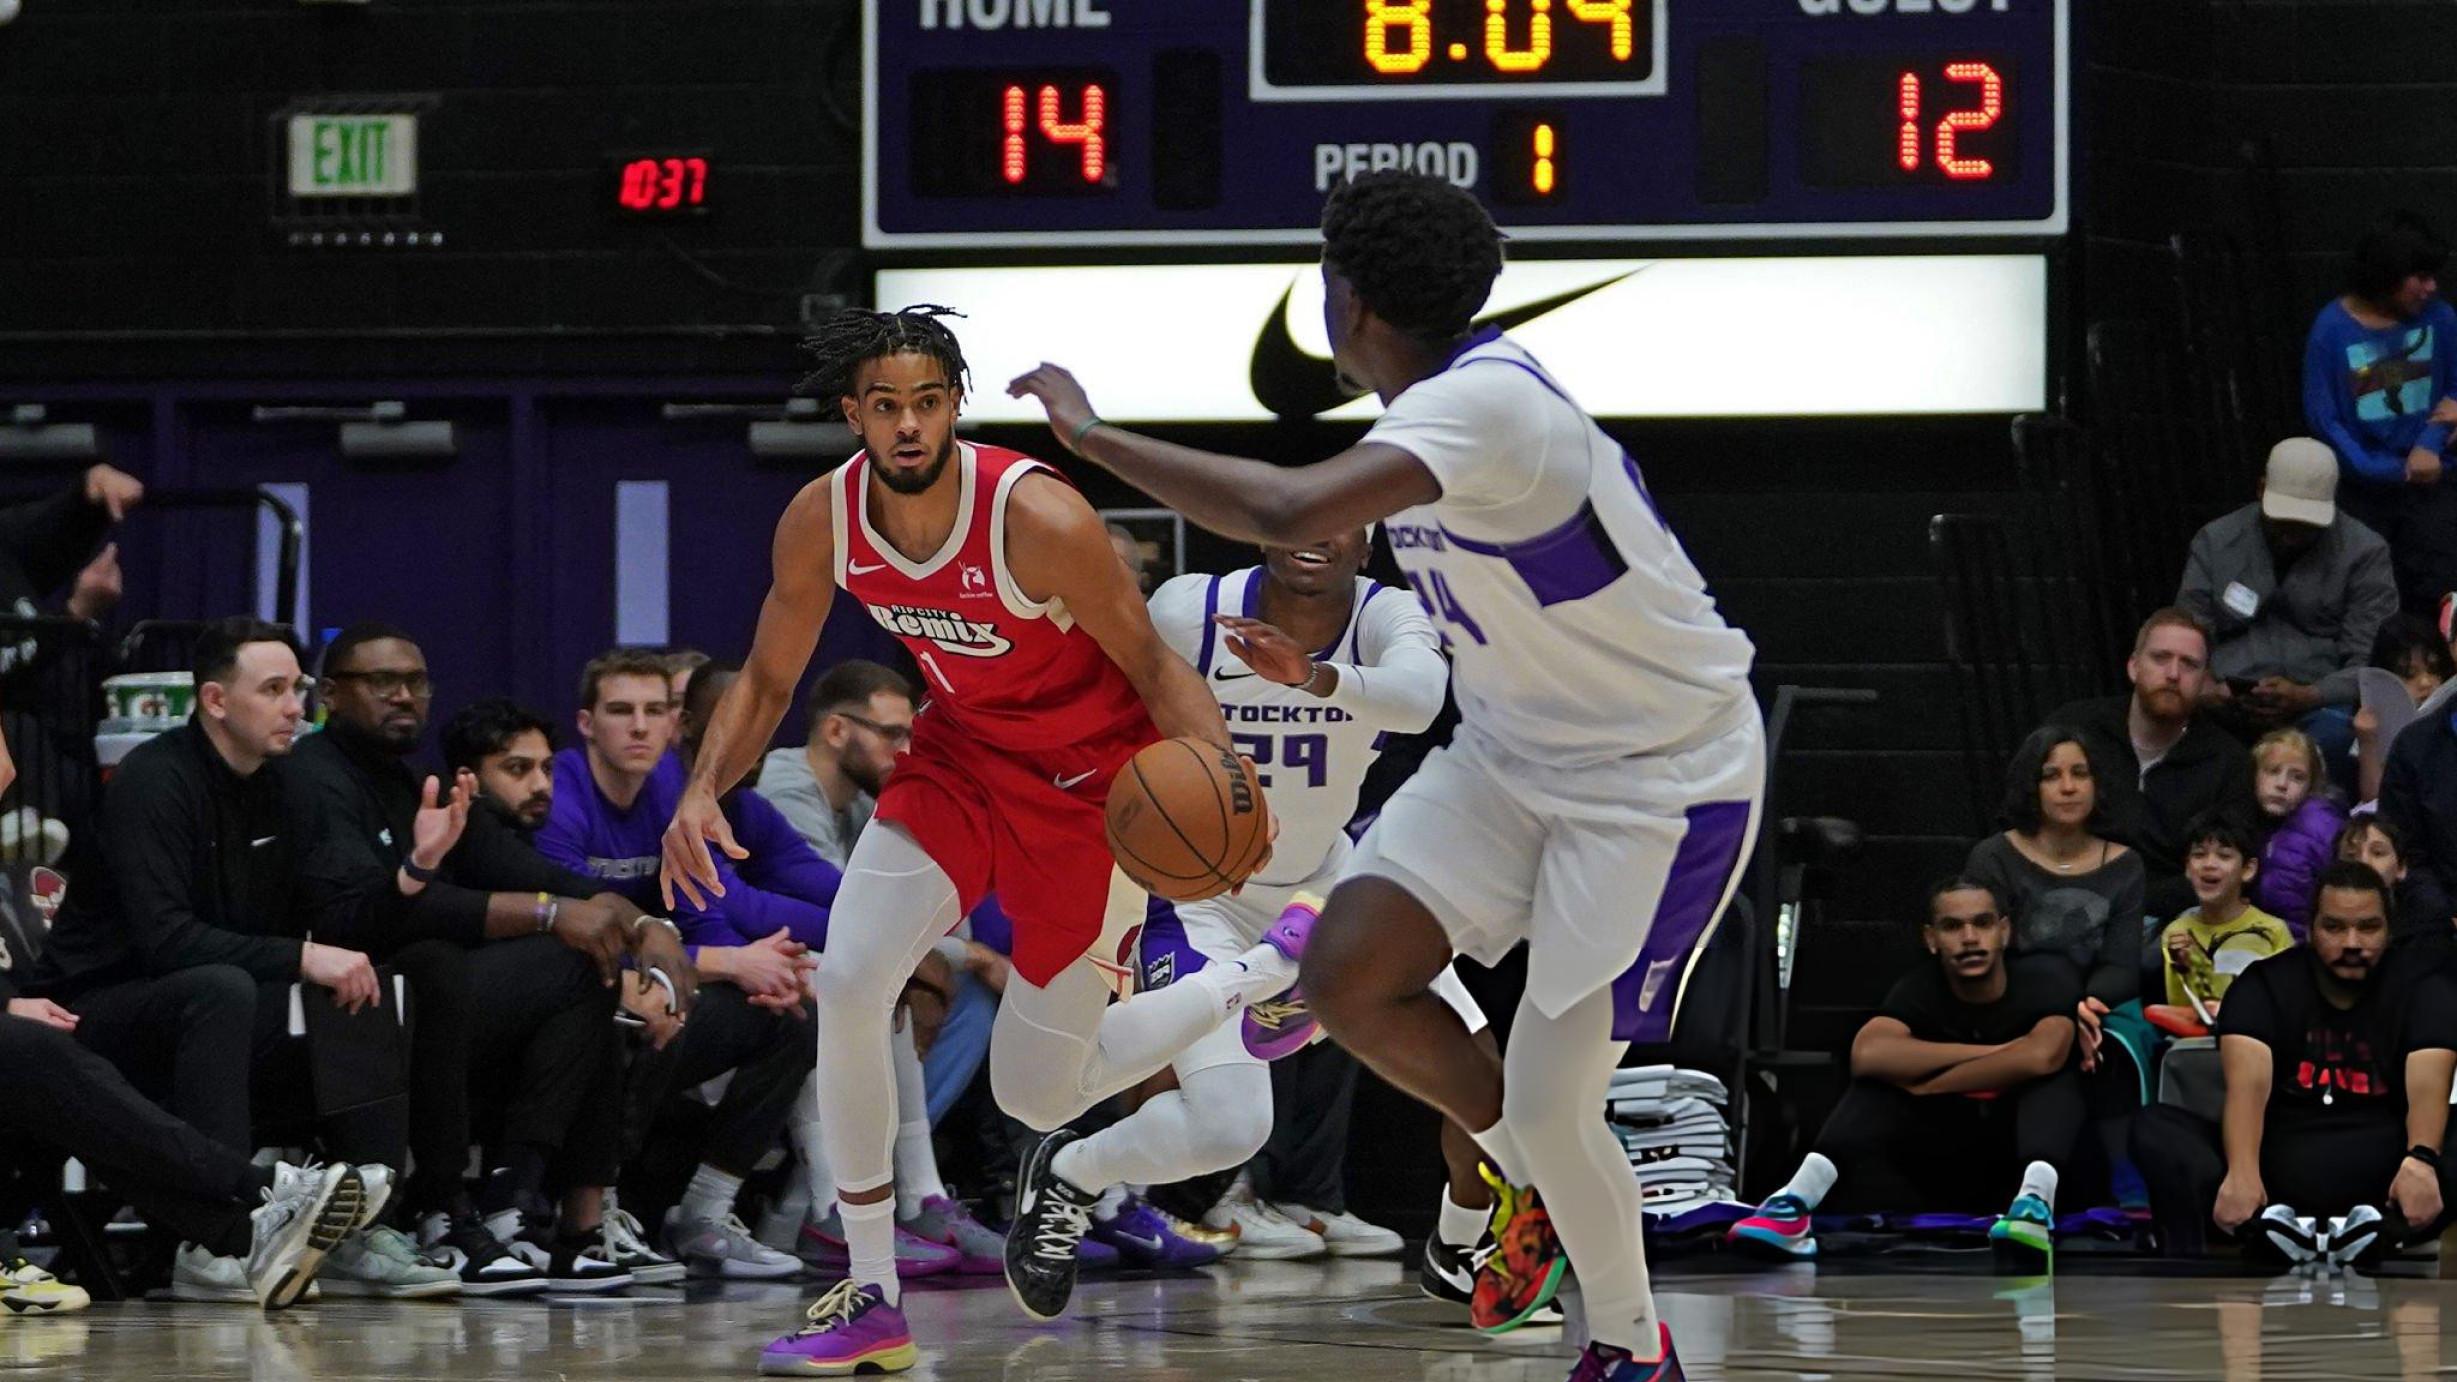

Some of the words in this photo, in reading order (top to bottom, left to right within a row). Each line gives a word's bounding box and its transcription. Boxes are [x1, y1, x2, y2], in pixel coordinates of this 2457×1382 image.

[1002, 83, 1105, 183] 14
[1901, 62, 2000, 179] 12
[312, 120, 390, 186] EXIT
[1534, 124, 1554, 194] 1
[867, 603, 1011, 657] Remix
[916, 607, 947, 619] CITY
[1221, 703, 1354, 723] TOCKTO
[1231, 732, 1328, 788] 29
